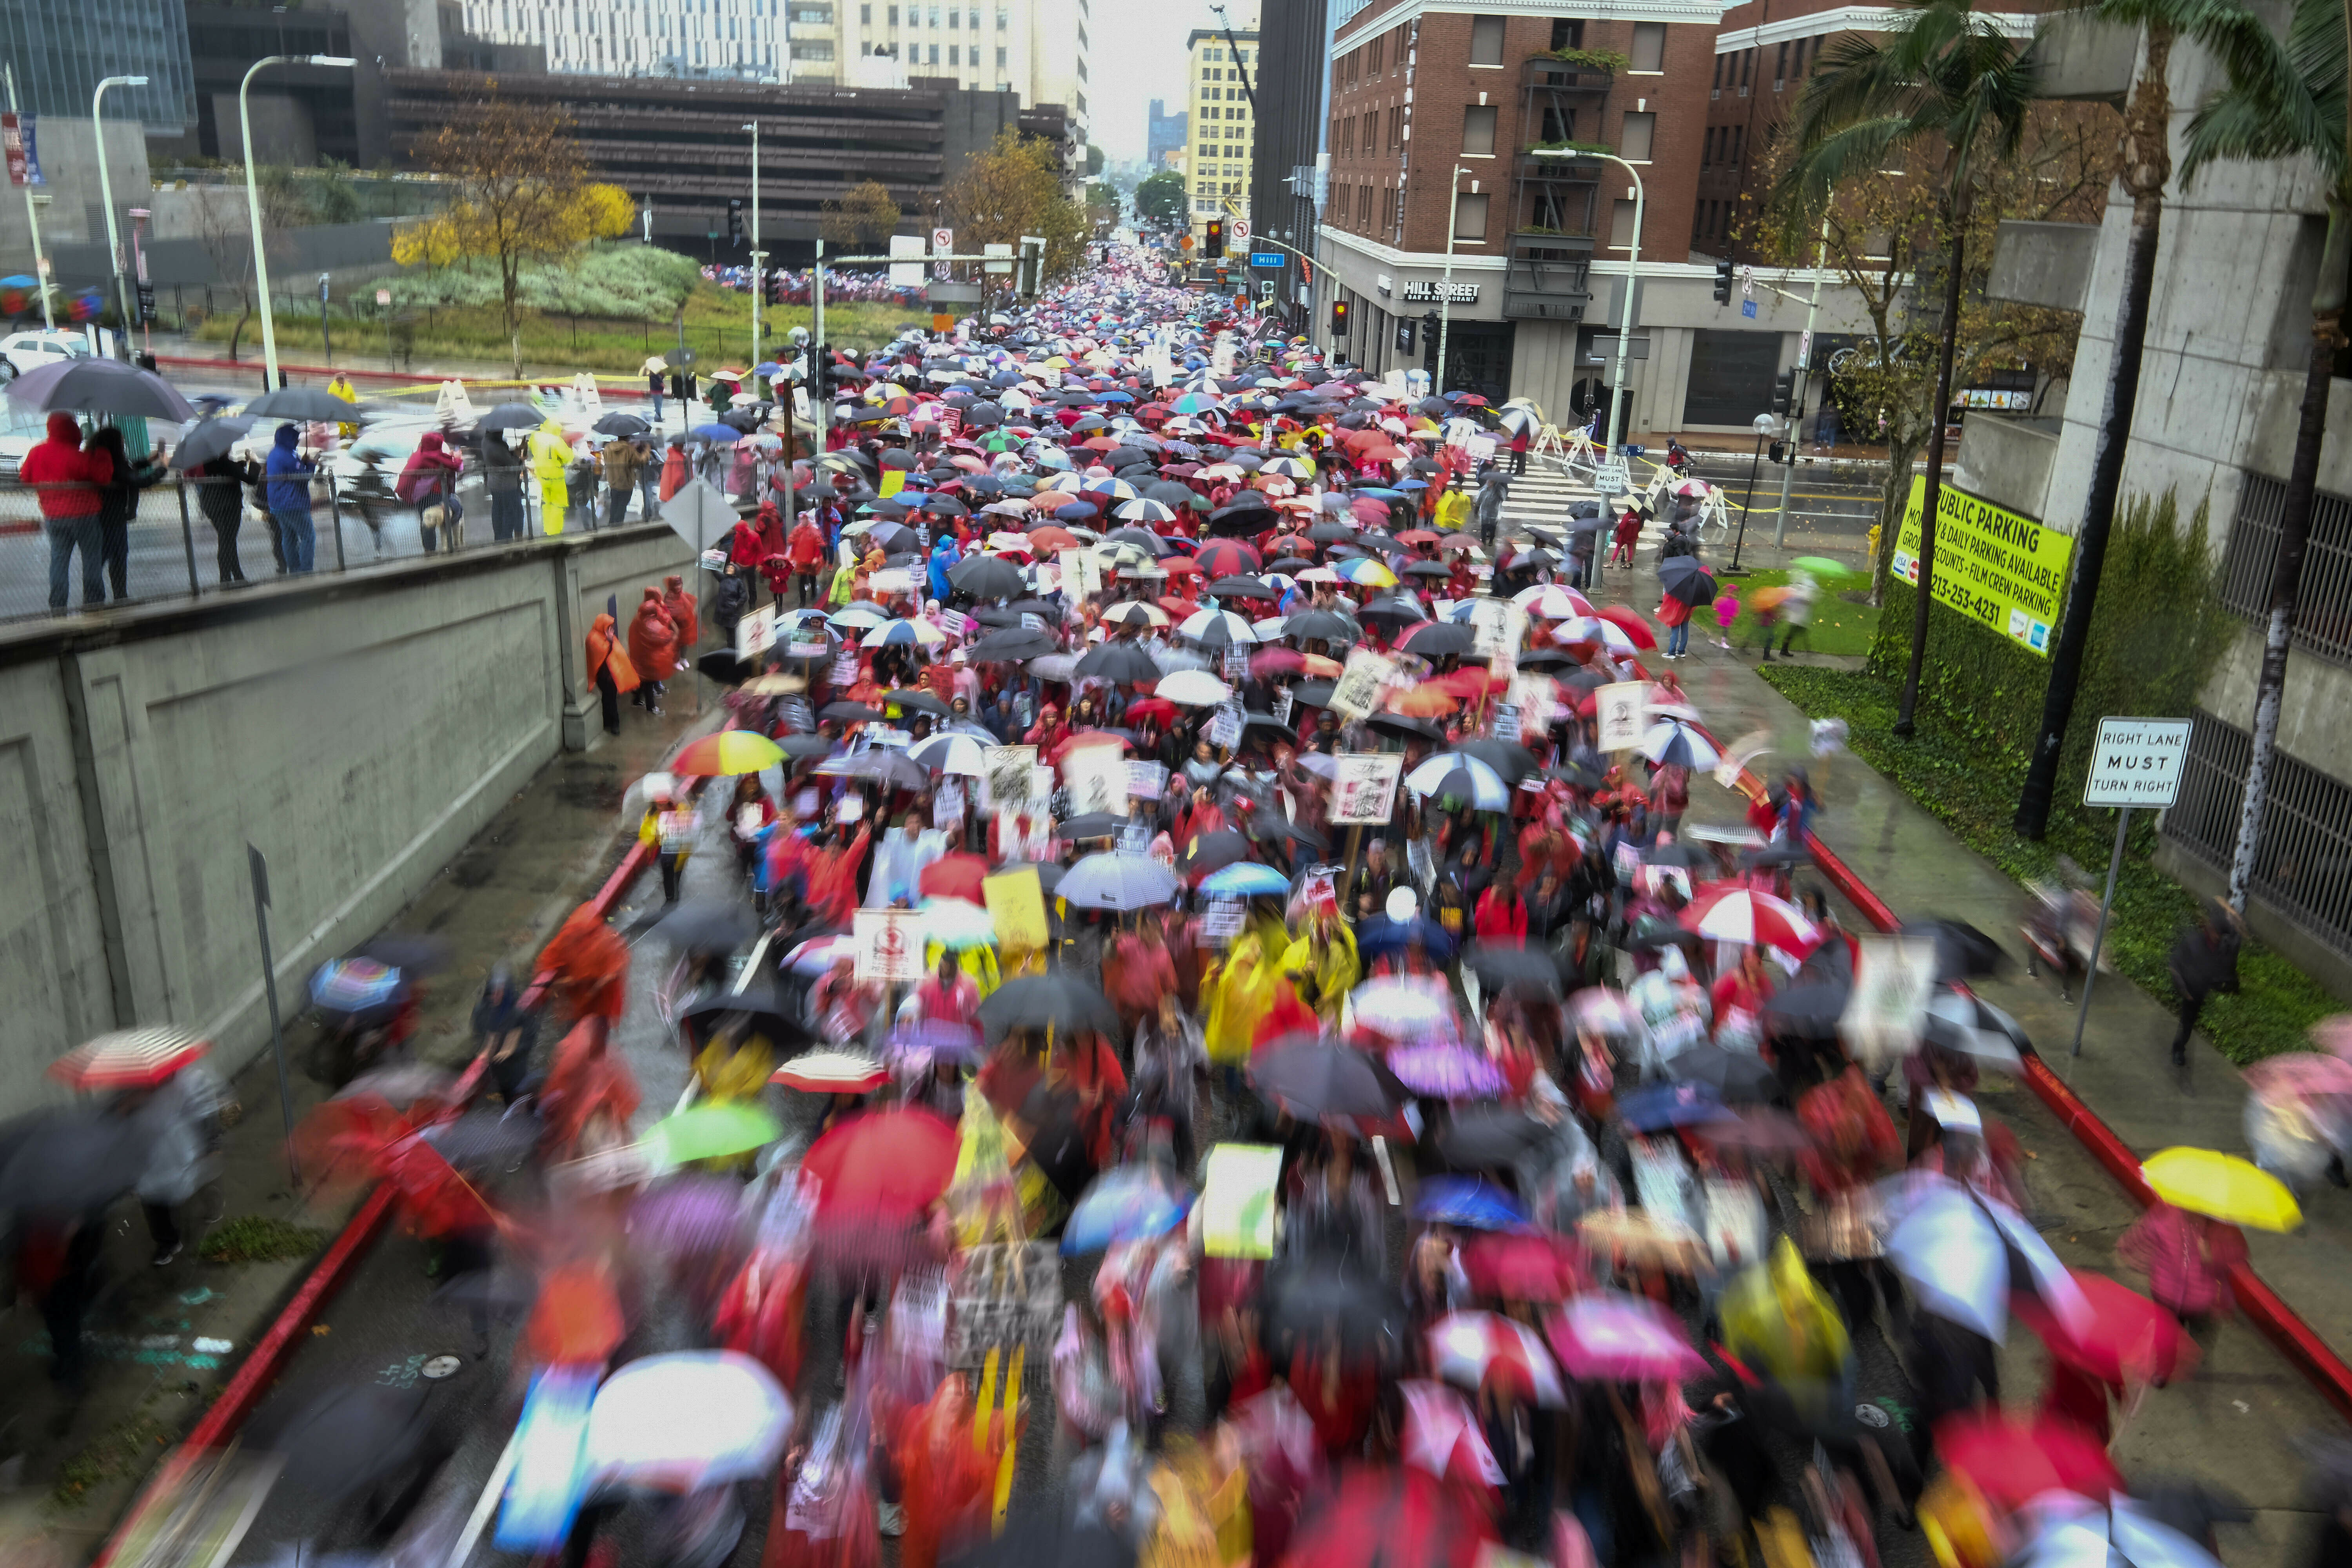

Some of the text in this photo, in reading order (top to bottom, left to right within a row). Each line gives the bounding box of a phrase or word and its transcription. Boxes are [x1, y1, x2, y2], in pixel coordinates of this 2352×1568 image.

[1404, 281, 1480, 296] HILL SREET
[1976, 506, 2040, 554] PARKING
[1896, 556, 1906, 567] VISA
[1940, 522, 1947, 540] &
[1947, 525, 1971, 551] DAILY
[1969, 535, 2007, 569] PARKING
[2007, 553, 2060, 592] AVAILABLE
[1903, 530, 1922, 552] GROU
[1934, 544, 1965, 573] SCOUNTS
[1969, 561, 1988, 585] FILM
[1988, 571, 2013, 597] CREW
[2012, 583, 2052, 617] PARKING
[1931, 573, 2001, 626] 213-253-4231
[2102, 732, 2183, 747] RIGHT LANE
[2107, 755, 2169, 771] MUST
[2093, 779, 2174, 793] TURN RIGHT
[1117, 838, 1146, 851] STRIKE
